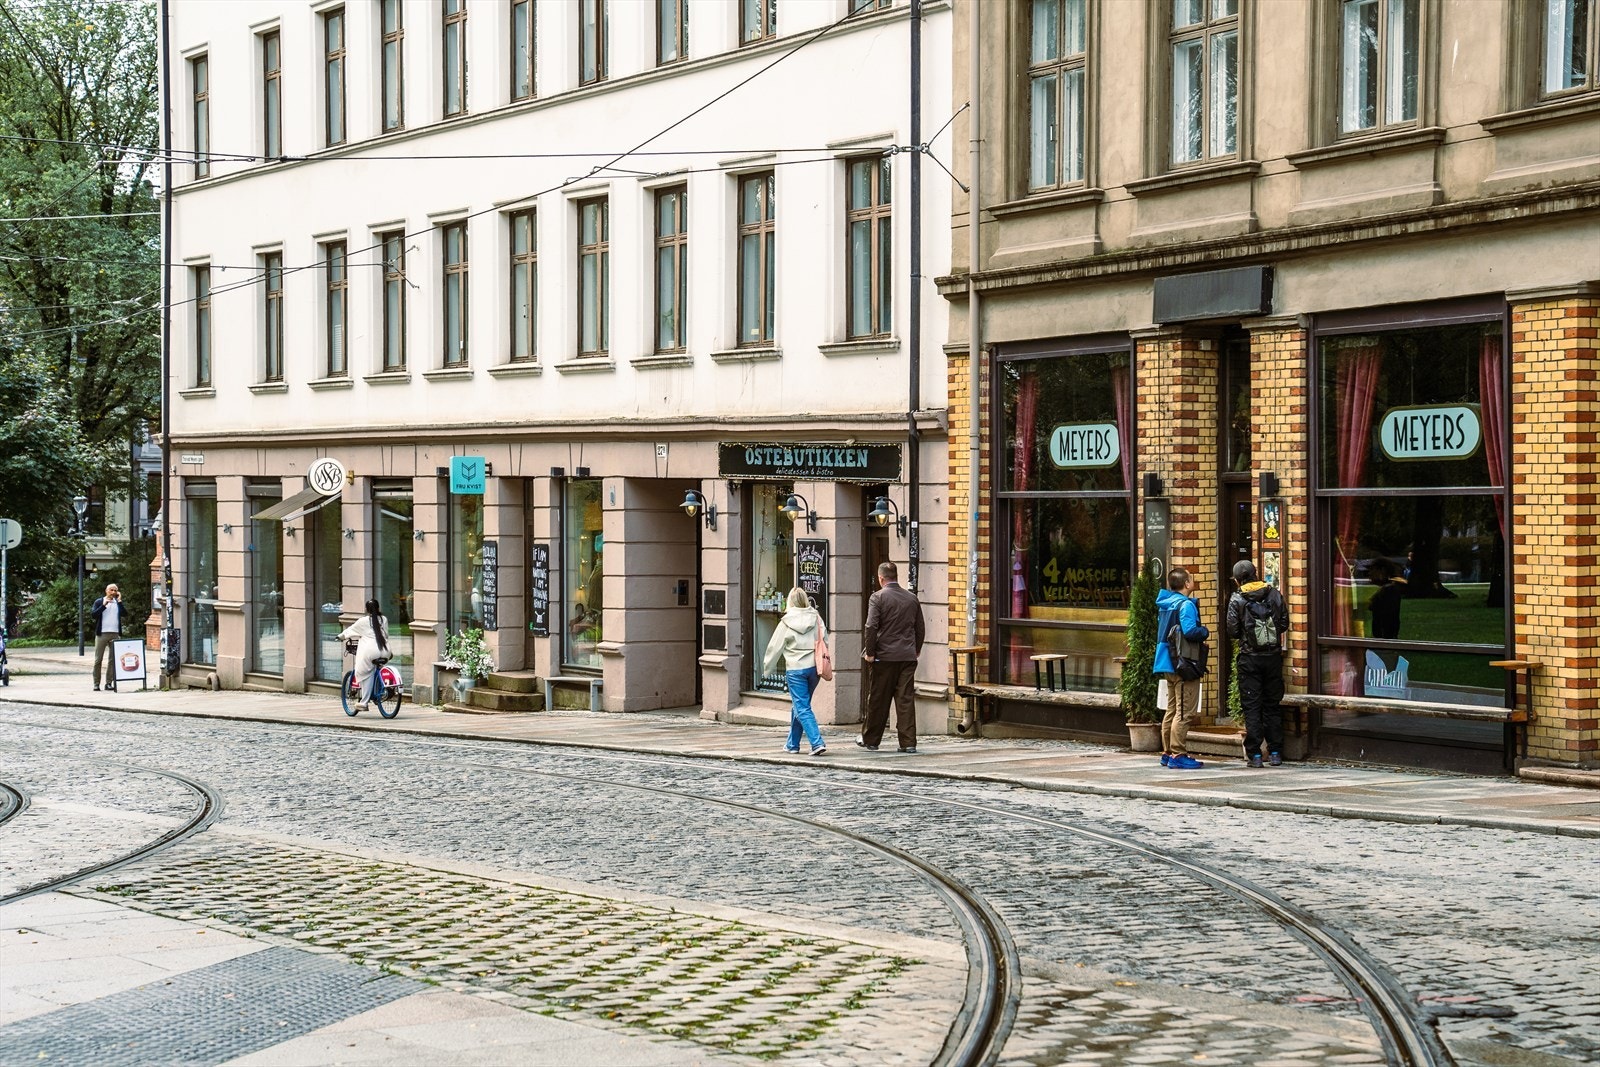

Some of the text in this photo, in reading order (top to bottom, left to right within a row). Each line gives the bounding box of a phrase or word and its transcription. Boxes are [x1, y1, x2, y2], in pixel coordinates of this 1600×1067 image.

[1059, 428, 1111, 461] MEYERS
[1394, 413, 1465, 452] MEYERS
[745, 447, 869, 468] OSTEBUTIKKEN
[816, 468, 834, 476] bistro
[800, 562, 820, 574] CHEESE
[1042, 556, 1061, 584] 4
[1063, 567, 1117, 583] MOSCHE
